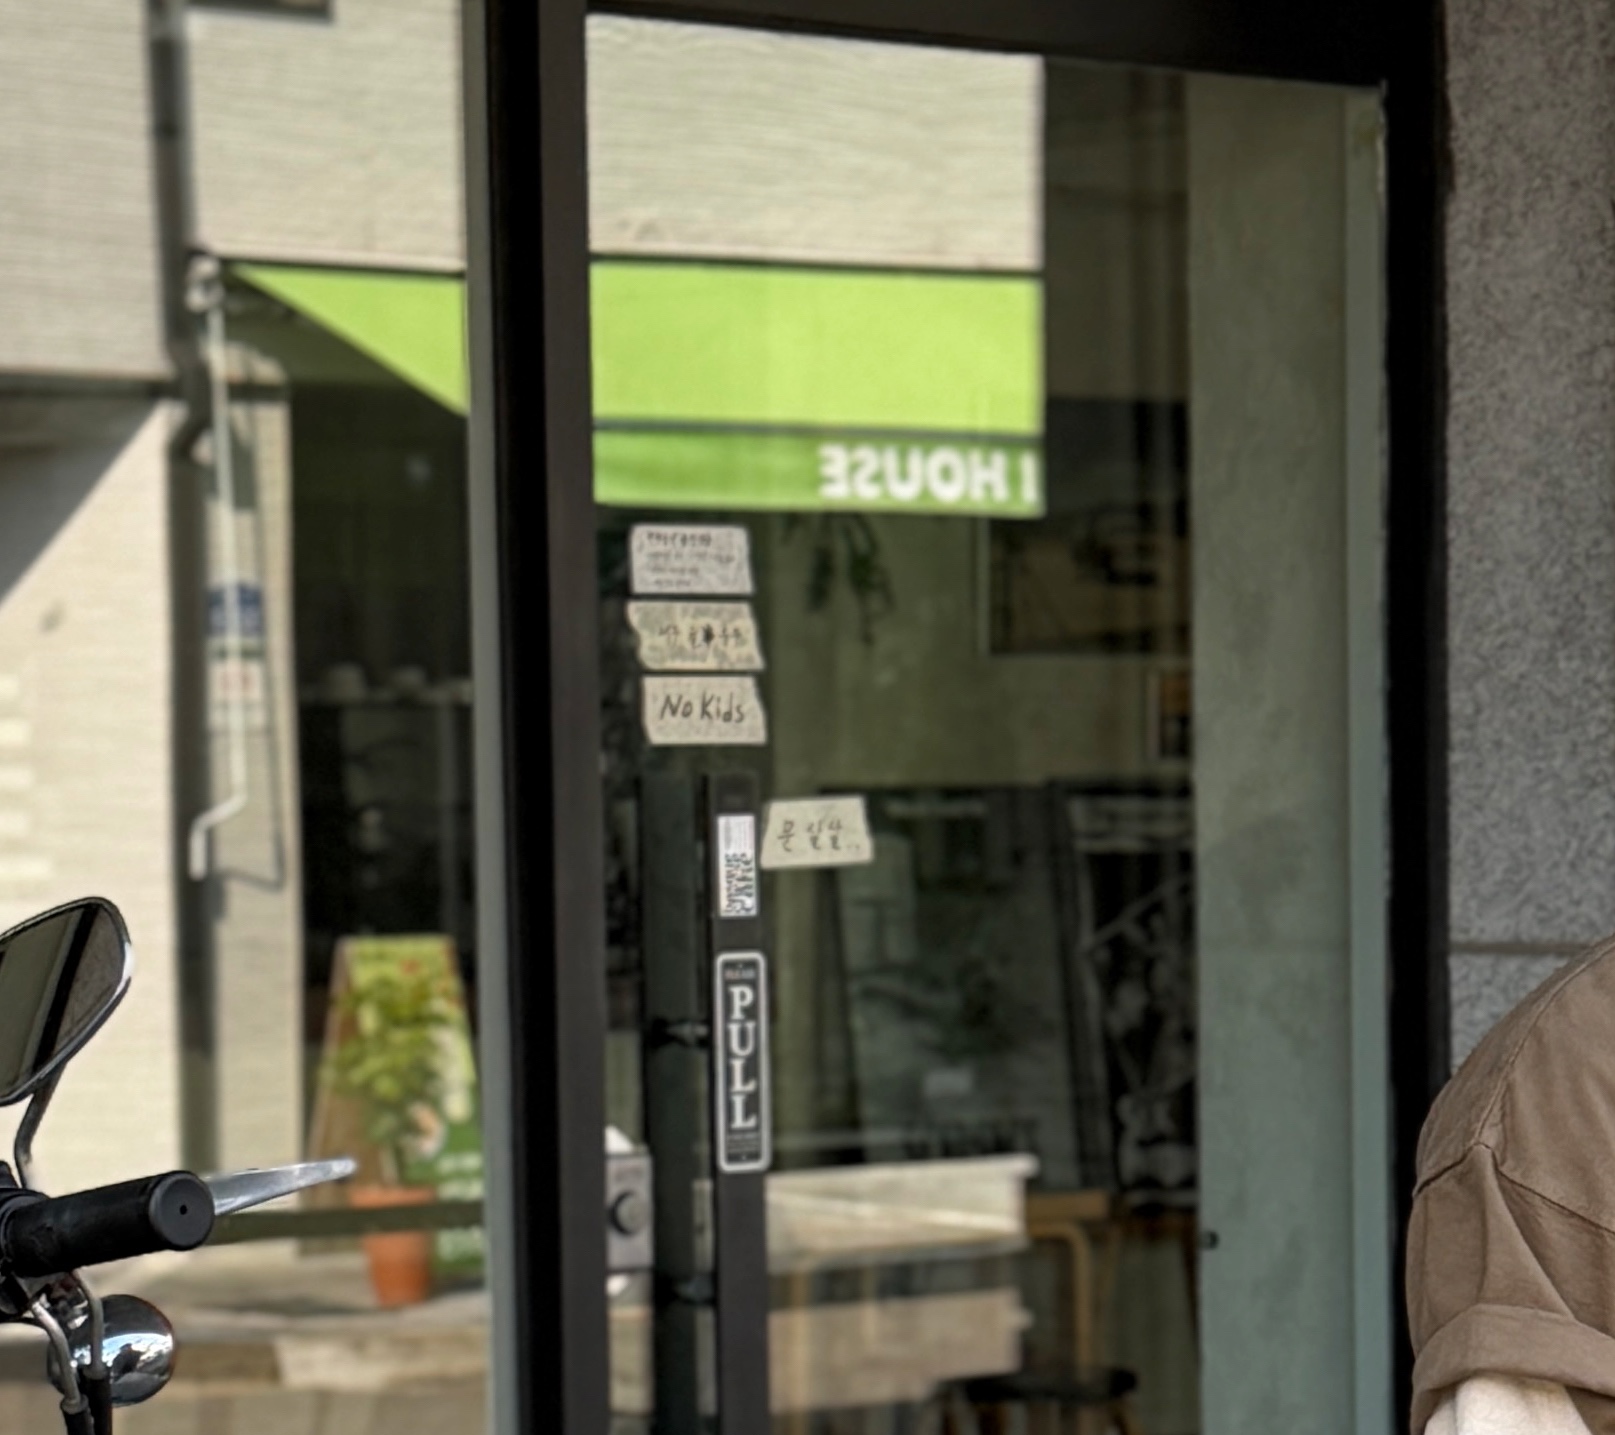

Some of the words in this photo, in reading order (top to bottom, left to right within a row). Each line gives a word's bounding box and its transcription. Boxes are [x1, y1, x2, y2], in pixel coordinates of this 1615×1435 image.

[660, 694, 694, 720] No
[701, 691, 745, 723] Kids
[728, 985, 757, 1129] PULL
